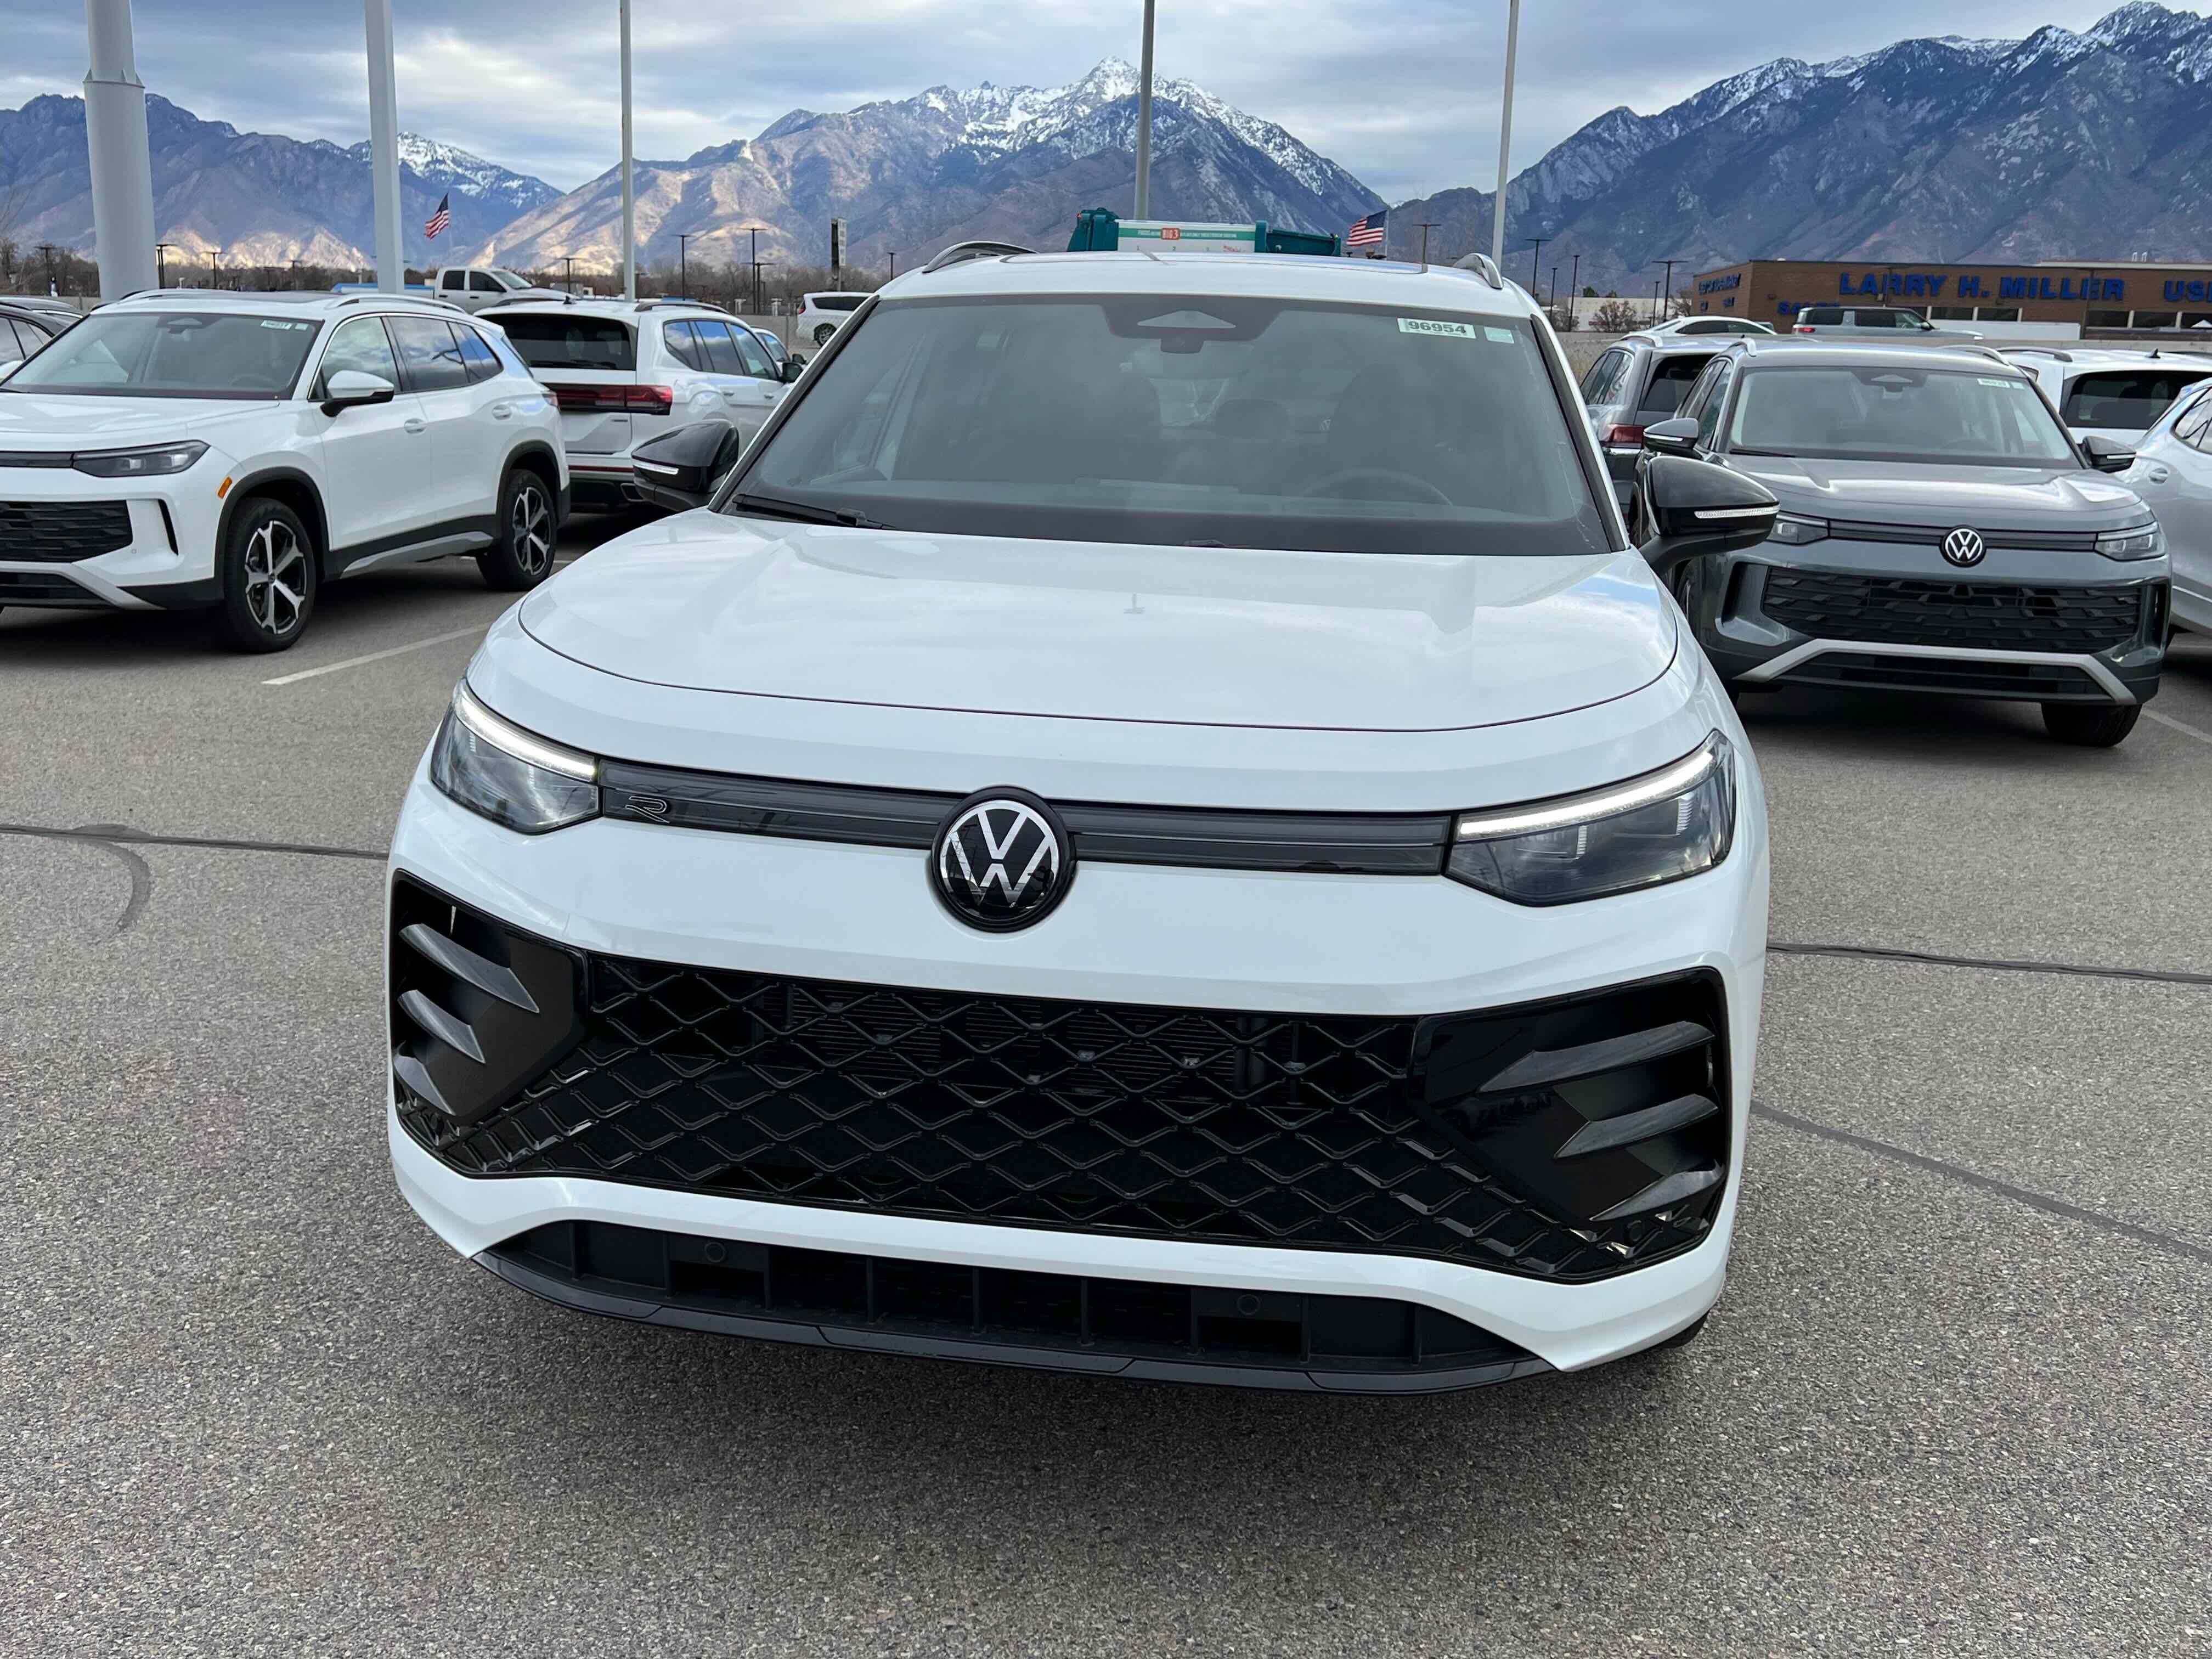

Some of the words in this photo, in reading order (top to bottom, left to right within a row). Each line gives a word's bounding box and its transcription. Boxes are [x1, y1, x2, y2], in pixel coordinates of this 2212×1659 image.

[1839, 272, 1947, 296] LARRY
[1957, 275, 1990, 298] H.
[1999, 276, 2125, 301] MILLER
[1408, 321, 1466, 334] 96954
[1945, 528, 1983, 562] VW
[940, 799, 1059, 918] VW
